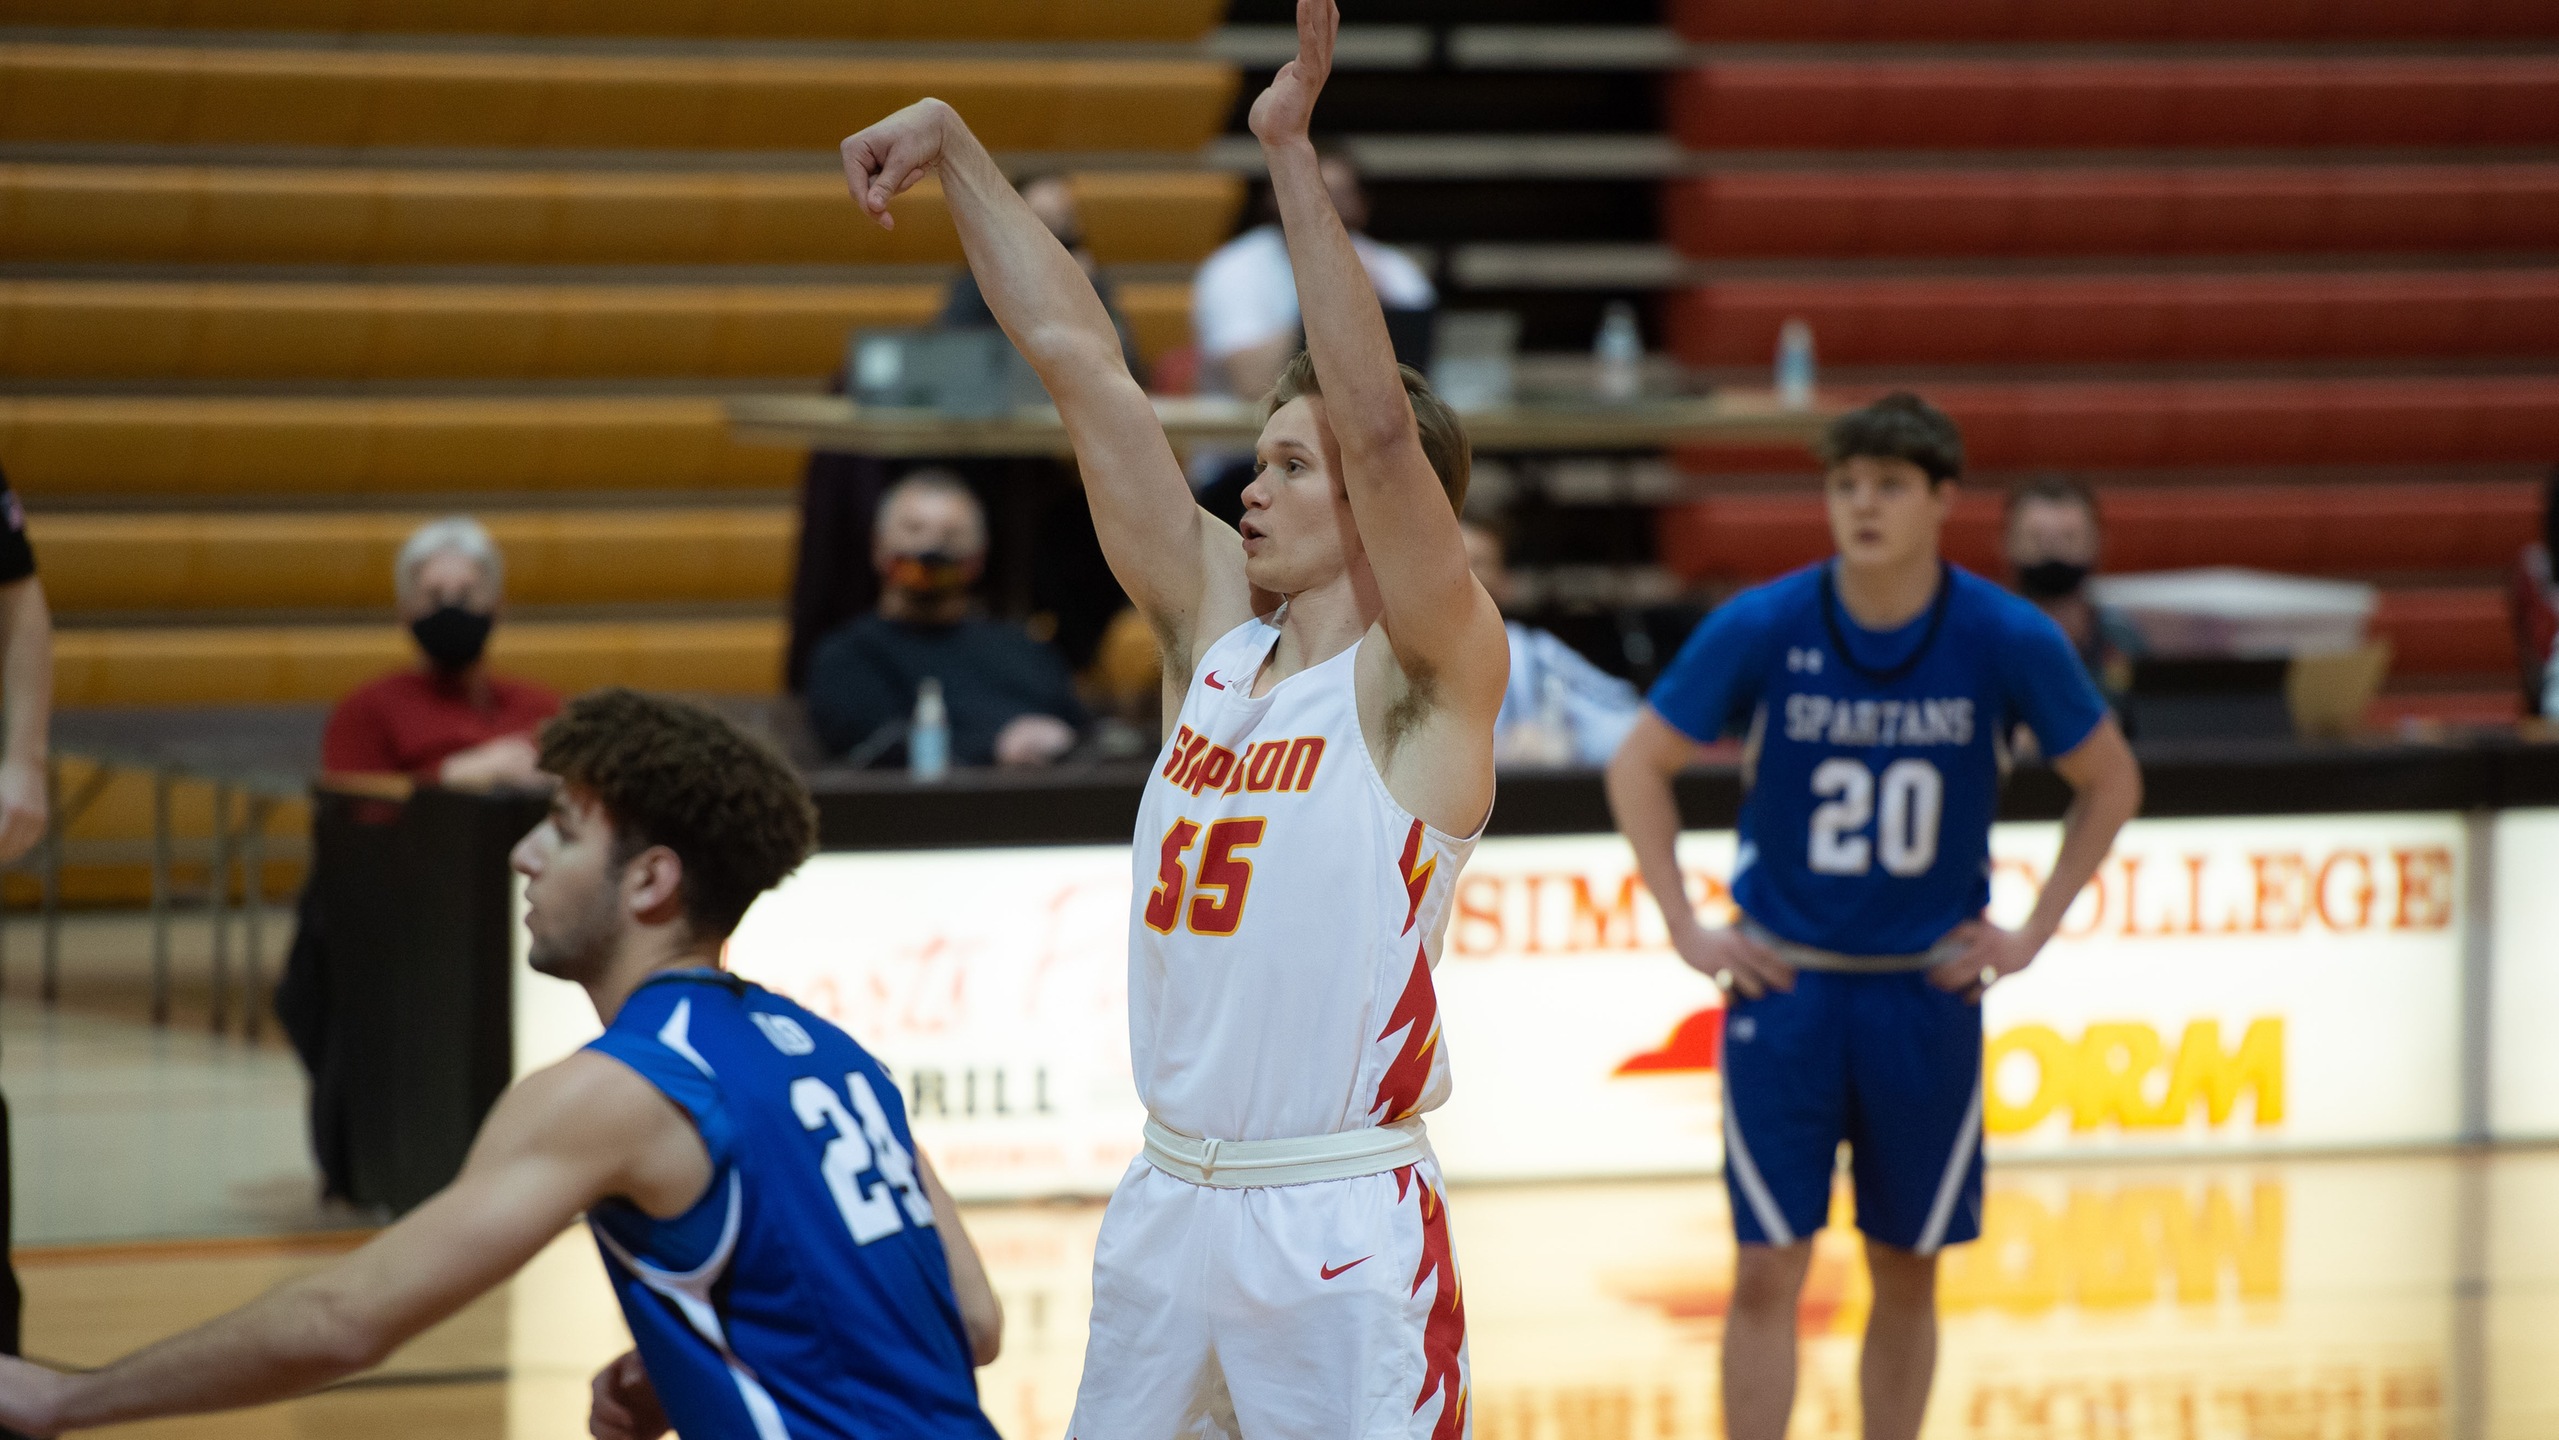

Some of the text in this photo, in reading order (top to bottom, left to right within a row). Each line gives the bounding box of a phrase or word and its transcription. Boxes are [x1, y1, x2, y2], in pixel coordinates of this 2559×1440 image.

[1784, 693, 1975, 747] SPARTANS
[1144, 815, 1268, 937] 55
[1807, 756, 1944, 878] 20
[789, 1069, 936, 1248] 24
